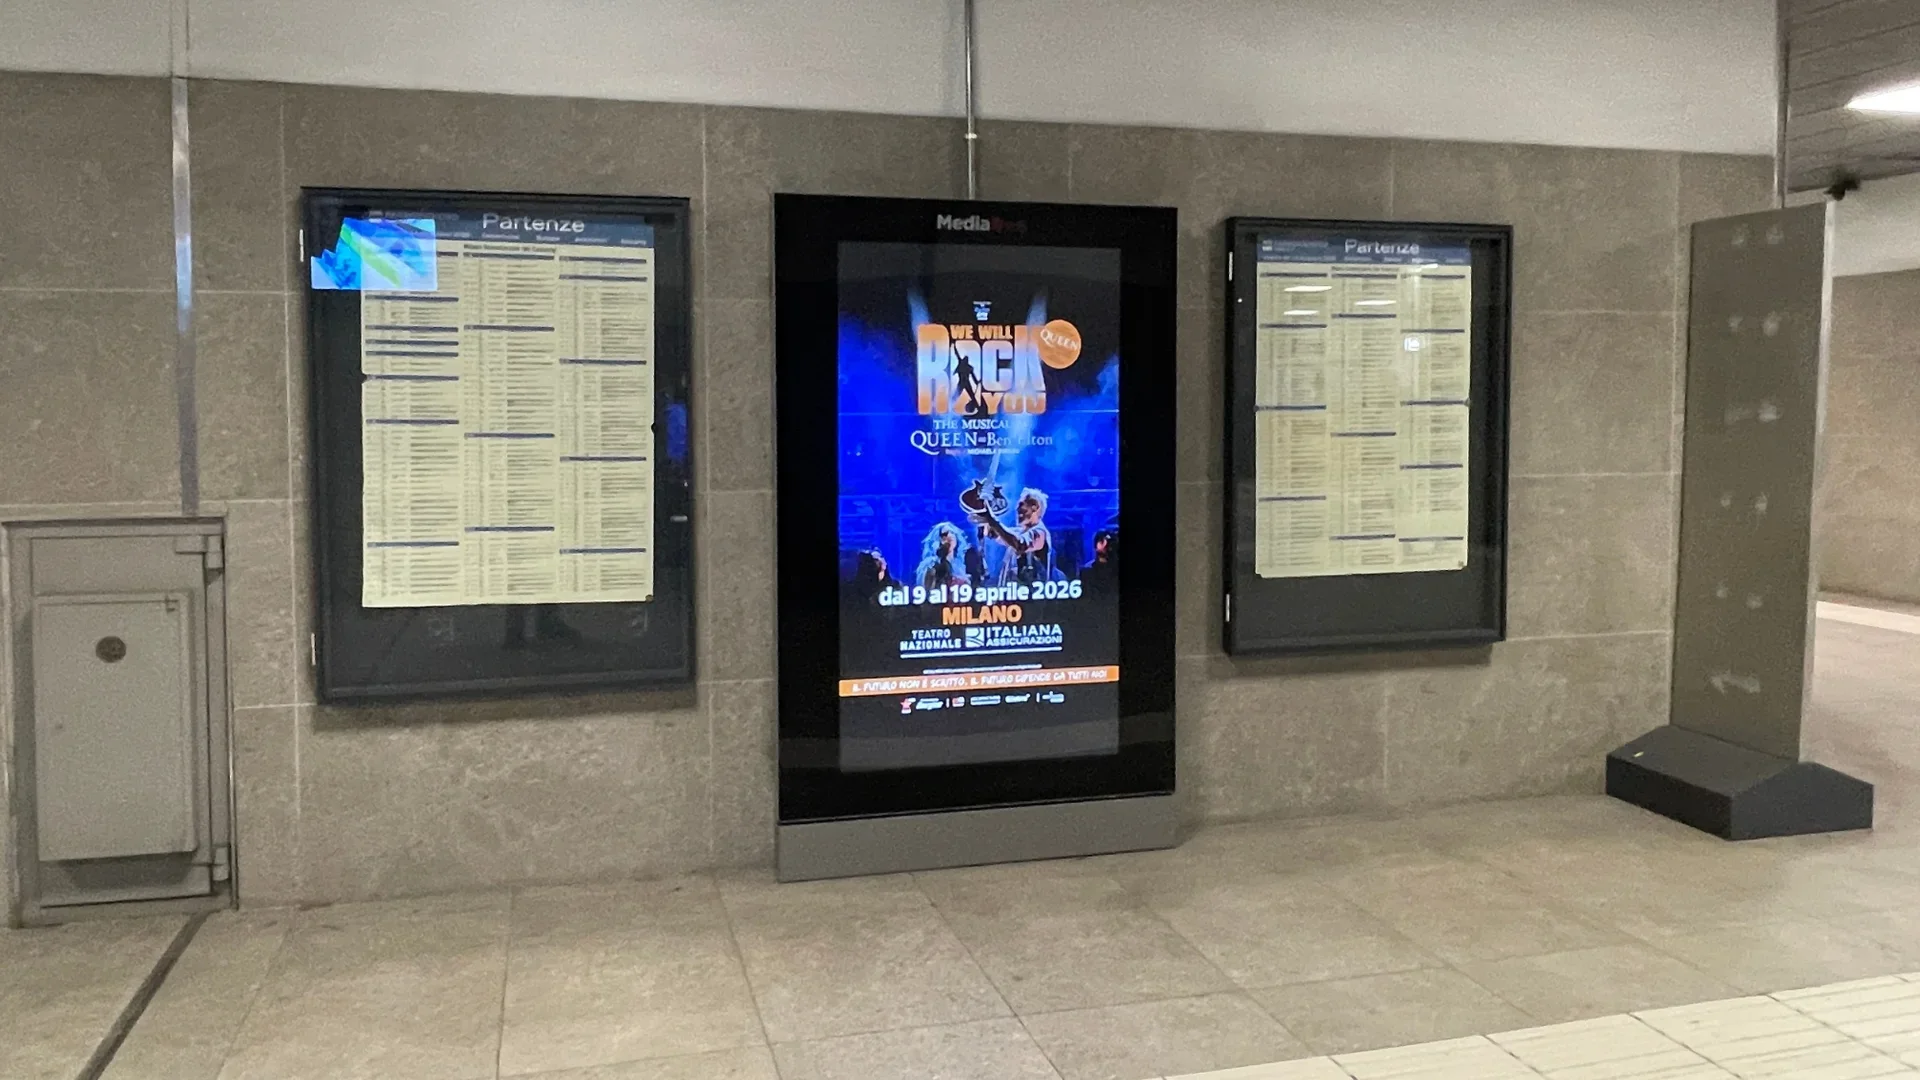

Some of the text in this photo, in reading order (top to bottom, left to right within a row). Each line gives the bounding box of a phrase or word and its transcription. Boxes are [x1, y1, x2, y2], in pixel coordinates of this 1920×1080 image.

[482, 212, 585, 232] Partenze
[1345, 238, 1420, 255] Partenze
[951, 324, 1013, 340] WE WILL
[1040, 328, 1079, 351] QUEEN
[917, 324, 1046, 415] ROCK
[981, 392, 1047, 415] YOU
[933, 419, 958, 430] THE
[962, 419, 1010, 430] MUSICAL
[910, 430, 978, 455] QUEEN
[878, 580, 1083, 606] dal 9 al 19 aprile 2026
[942, 604, 1023, 625] MILANO
[911, 628, 951, 639] TEATRO
[986, 624, 1063, 638] ITALIANA
[900, 638, 962, 651] NAZIONALE
[985, 635, 1063, 647] ASSICURAZIONI
[899, 680, 919, 689] NON
